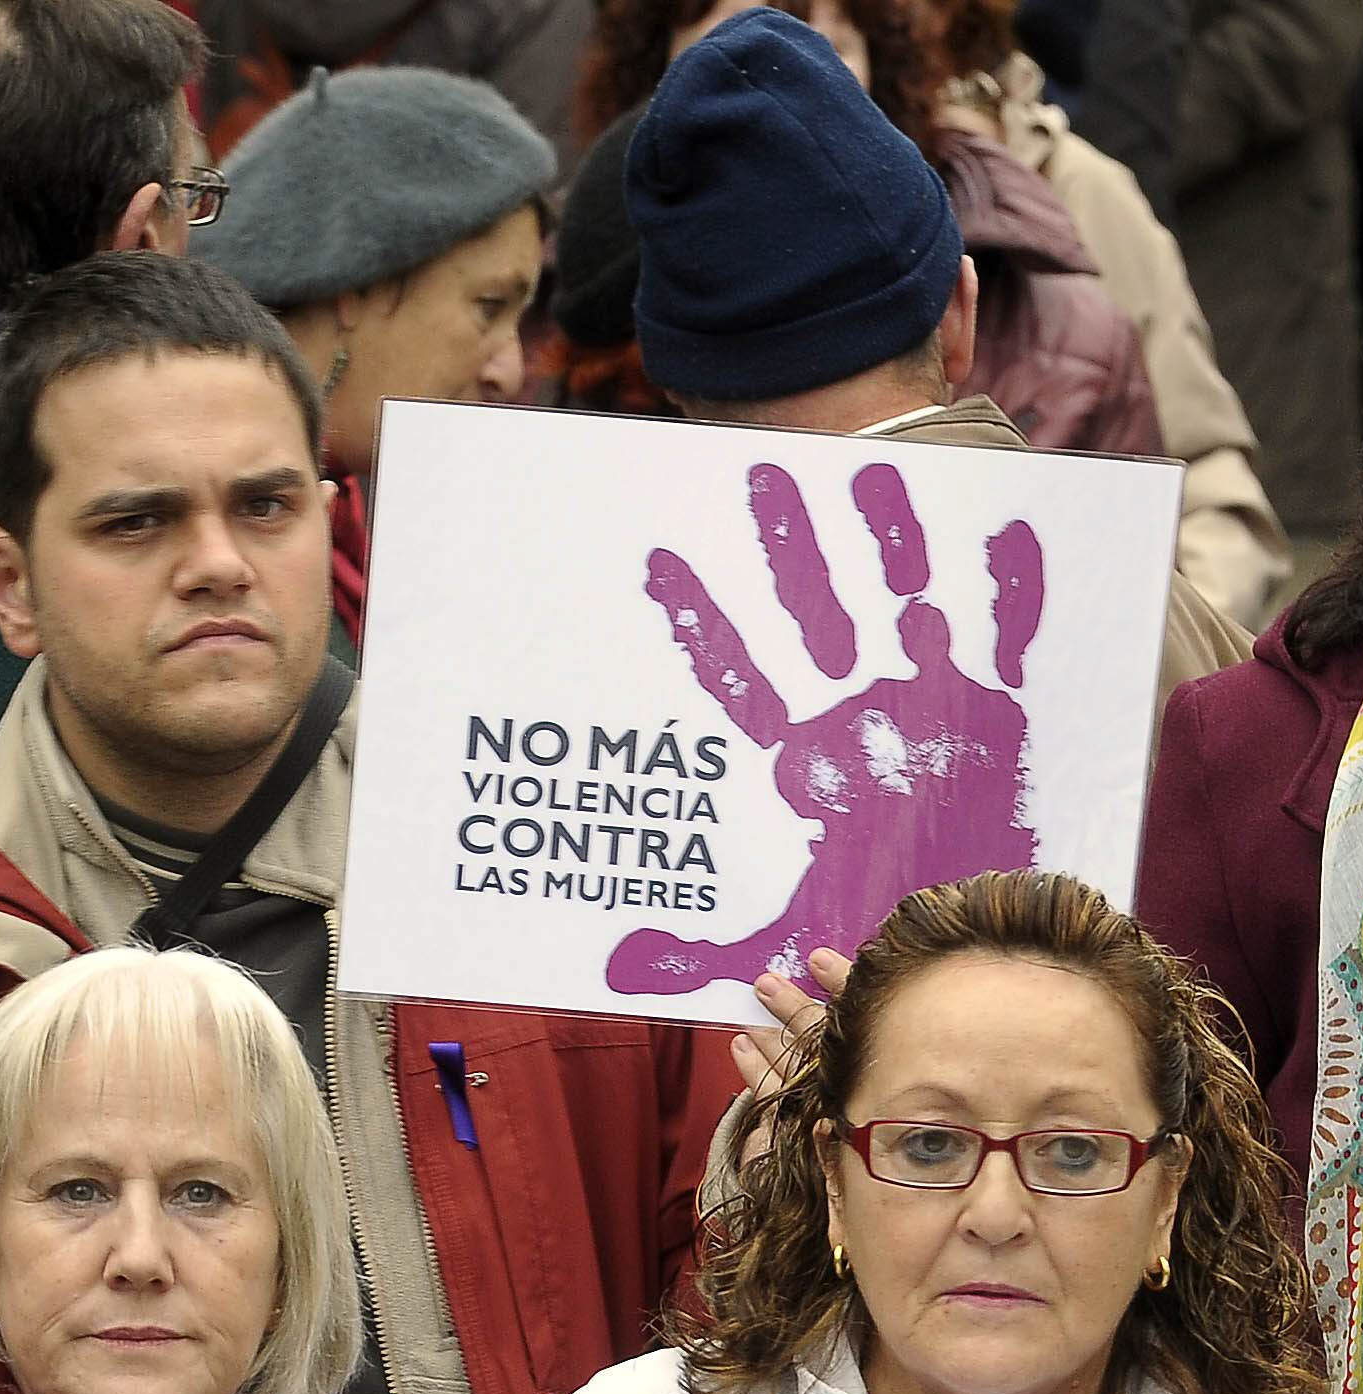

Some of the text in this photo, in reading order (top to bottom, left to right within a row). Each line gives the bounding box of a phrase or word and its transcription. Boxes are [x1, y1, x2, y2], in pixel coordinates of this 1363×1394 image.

[466, 715, 728, 780] NO MÁS
[463, 772, 720, 824] VIOLENCIA
[458, 815, 717, 875] CONTRA
[454, 864, 717, 912] LAS MUJERES
